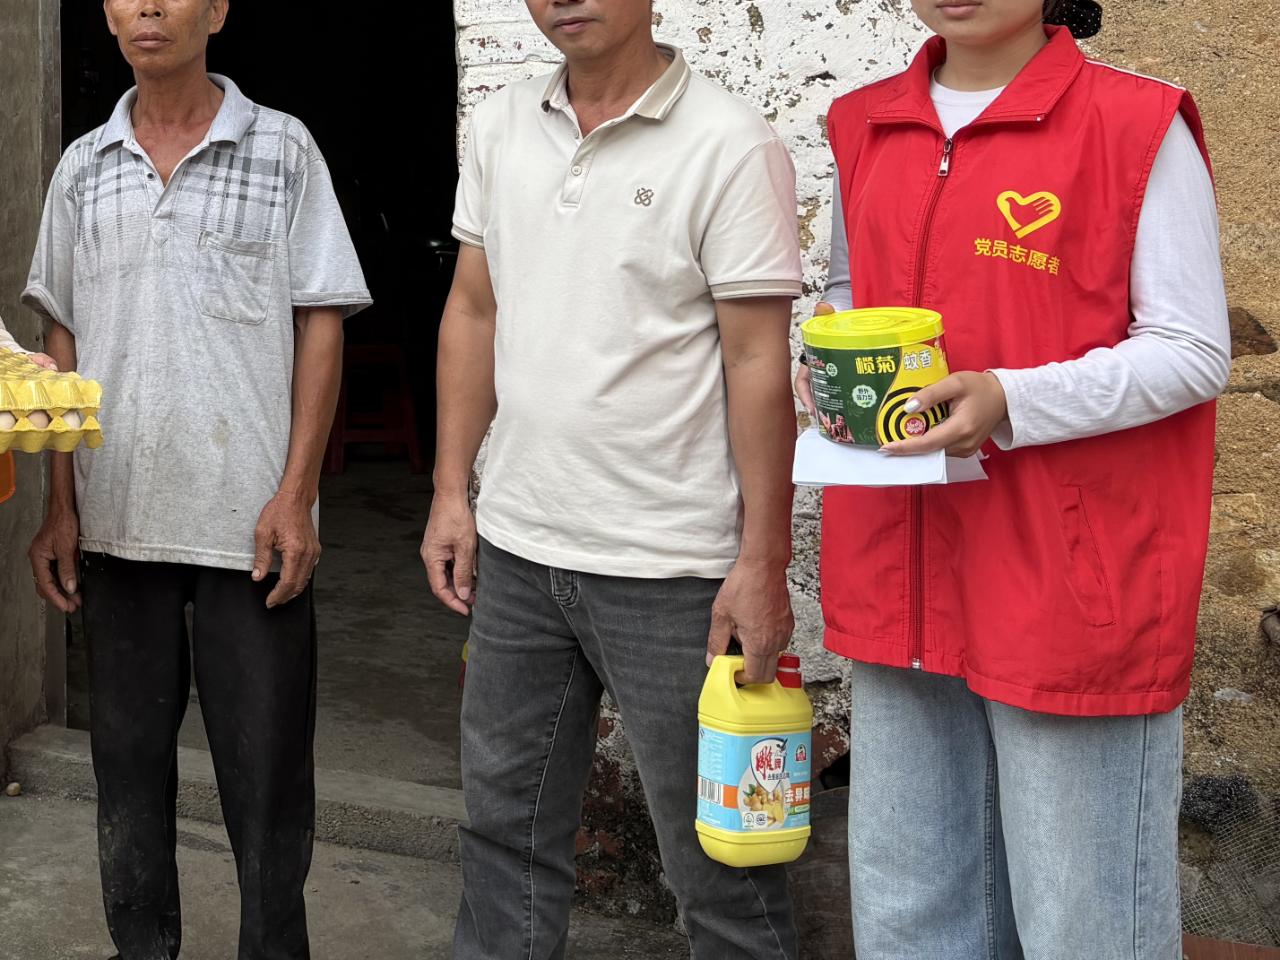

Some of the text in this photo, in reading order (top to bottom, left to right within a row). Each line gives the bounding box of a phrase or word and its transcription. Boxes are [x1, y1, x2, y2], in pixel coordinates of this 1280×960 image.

[974, 237, 1061, 276] 党员志愿者
[855, 355, 896, 375] 榄菊
[904, 349, 932, 371] 蚊香
